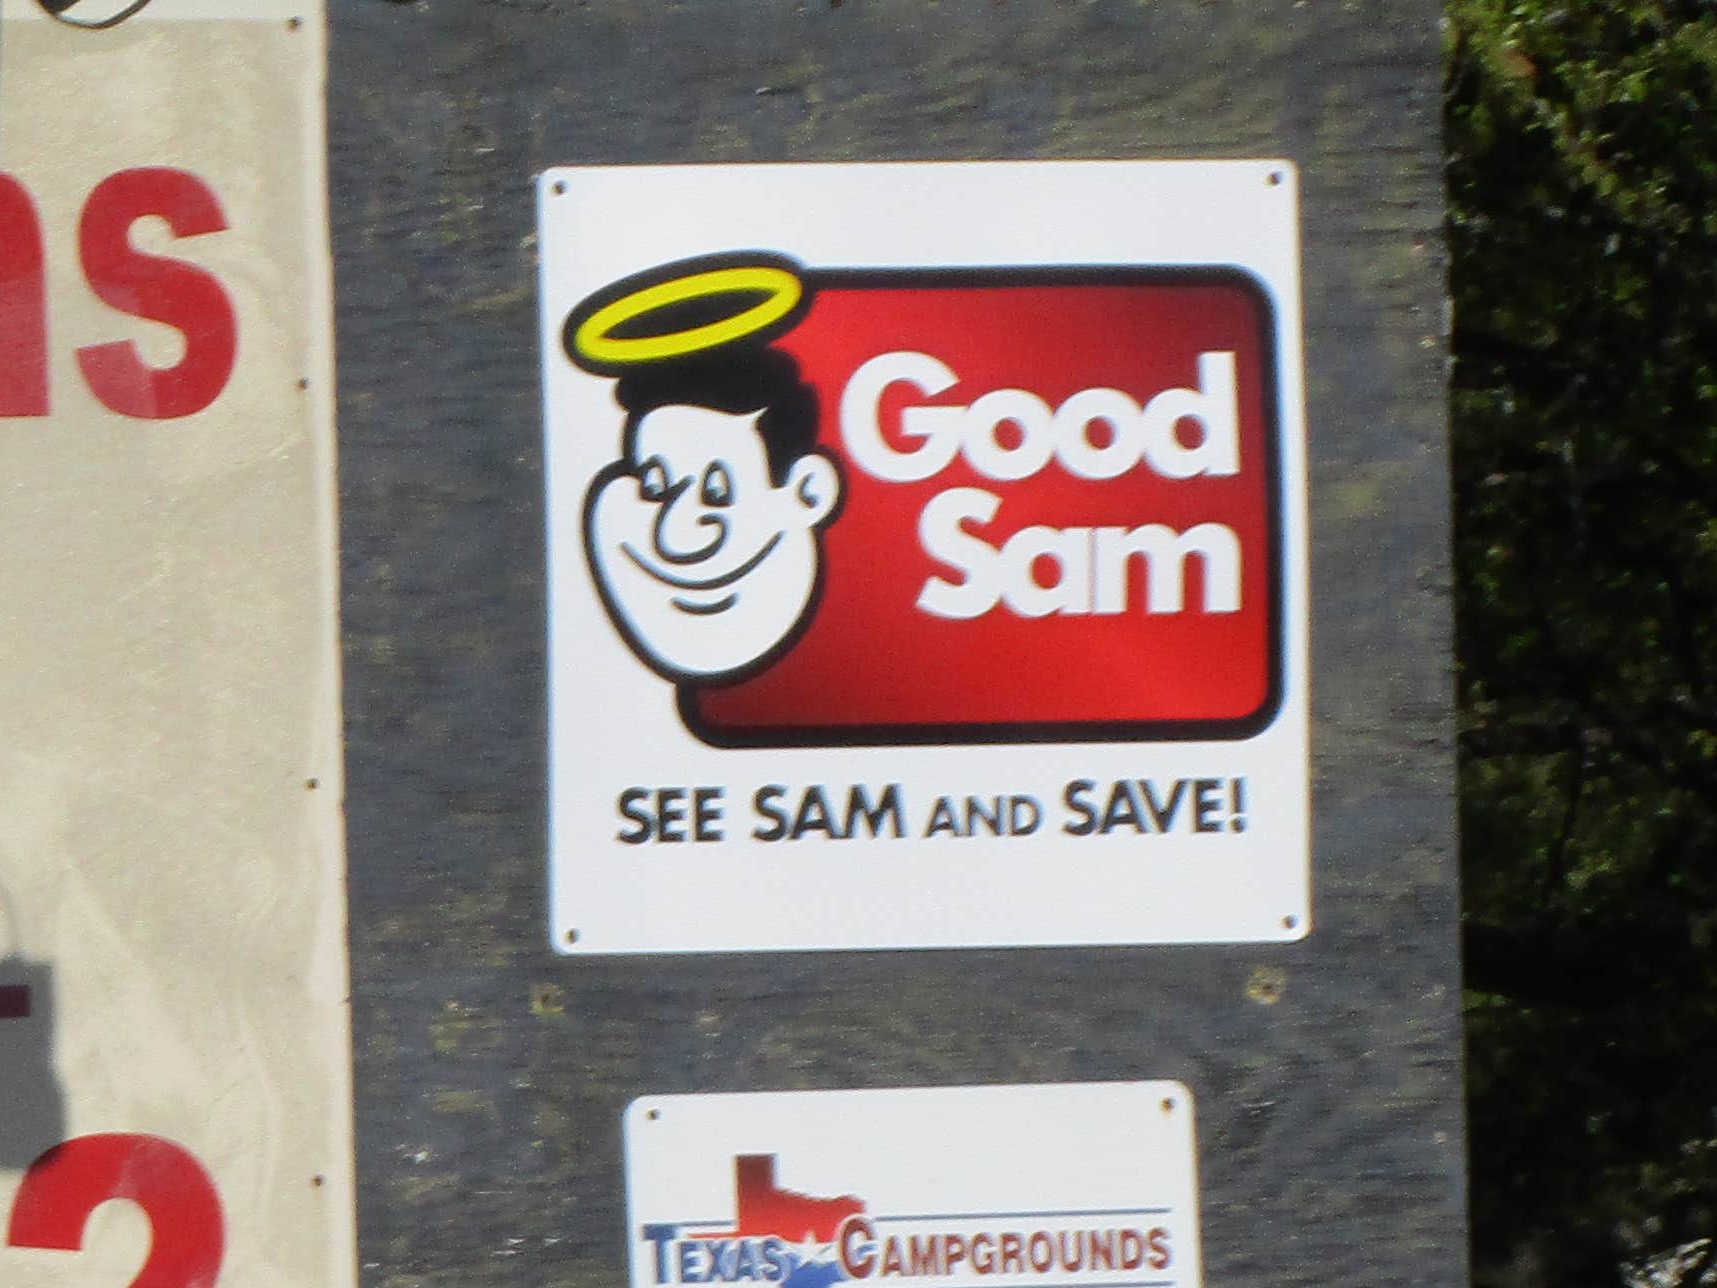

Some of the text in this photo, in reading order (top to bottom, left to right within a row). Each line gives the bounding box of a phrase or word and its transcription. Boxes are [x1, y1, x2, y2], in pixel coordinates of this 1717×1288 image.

[840, 351, 1240, 483] Good
[916, 487, 1241, 620] Sam
[616, 778, 1248, 846] SEE SAM AND SAVE!
[643, 1216, 1172, 1285] TEXAS CAMPGROUNDS
